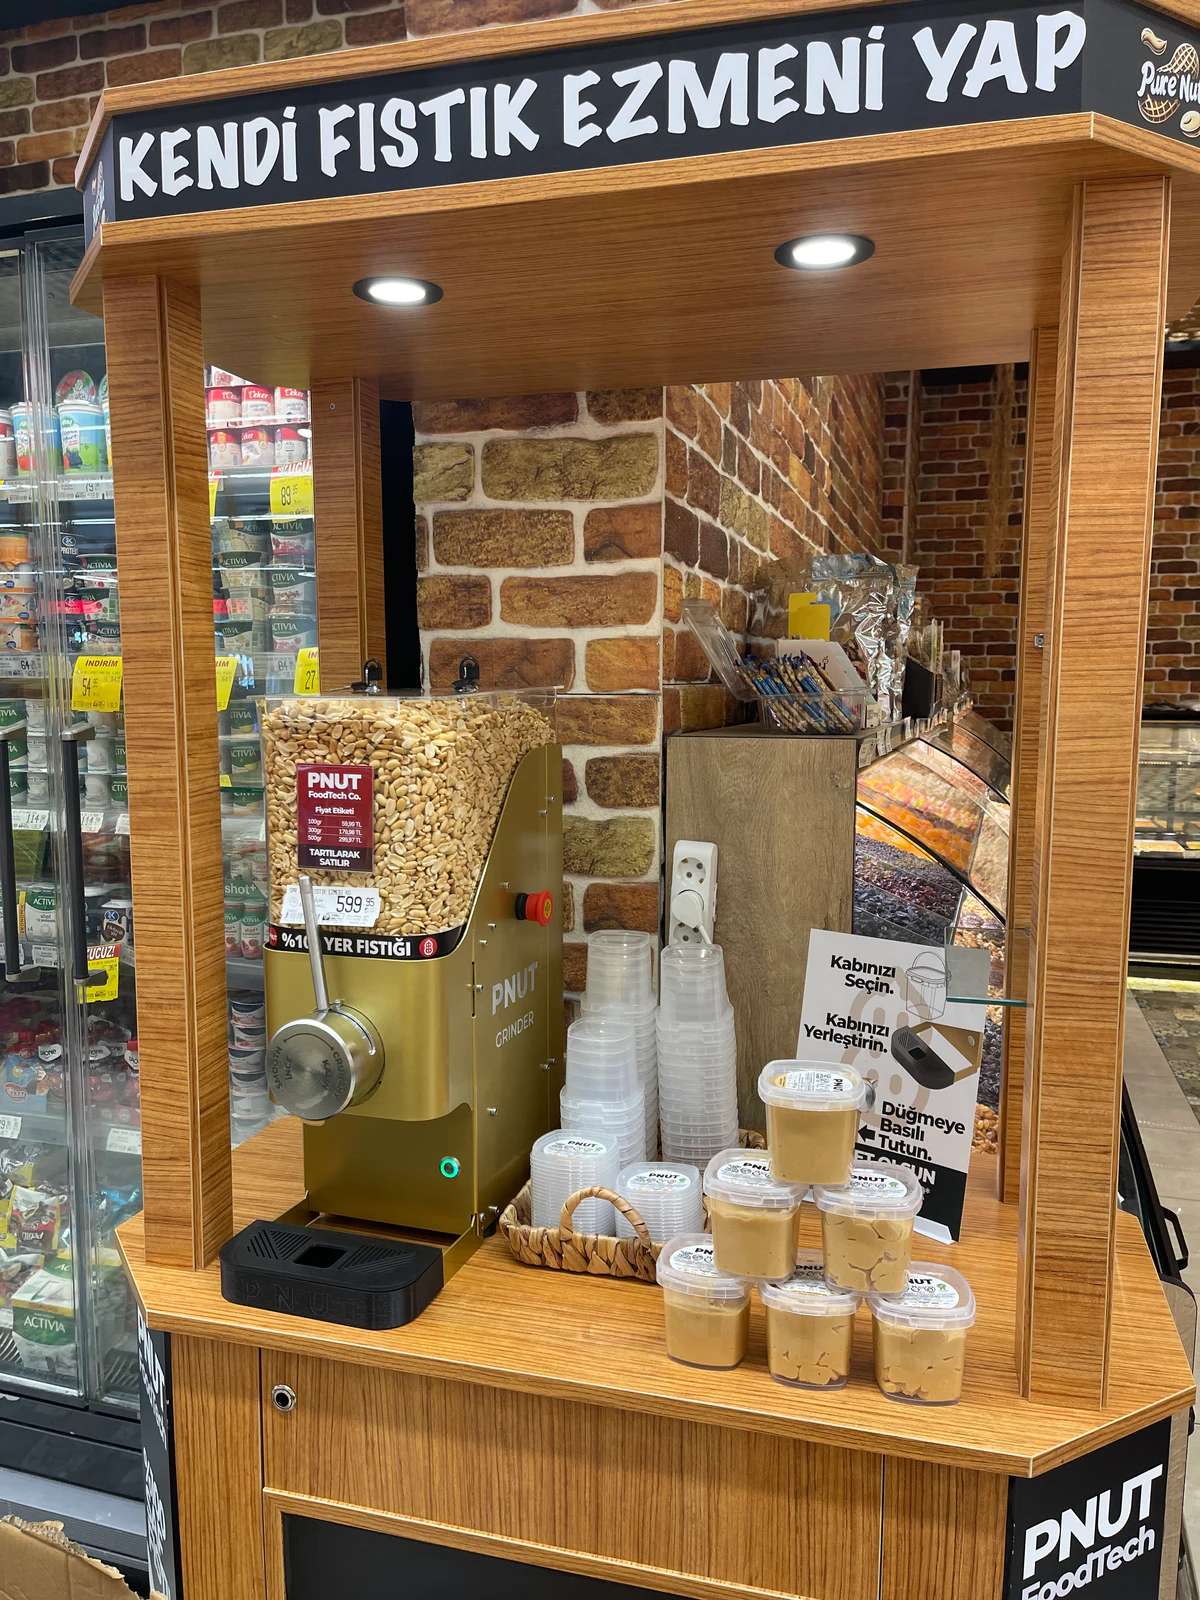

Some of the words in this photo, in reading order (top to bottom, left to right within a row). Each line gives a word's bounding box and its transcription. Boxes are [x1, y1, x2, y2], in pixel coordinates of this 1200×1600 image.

[1136, 60, 1177, 98] Pure
[119, 106, 298, 202] KENDİ
[318, 77, 539, 178] FISTIK
[562, 26, 885, 148] EZMENİ
[912, 10, 1087, 103] YAP
[280, 485, 292, 506] 89
[273, 522, 304, 531] ACTIVIA
[87, 561, 112, 569] ACTIVIA
[223, 557, 248, 566] ACTIVIA
[271, 573, 296, 582] CTIVIA
[85, 659, 118, 667] İNDİRİM
[230, 711, 252, 719] CTIVIA
[307, 772, 362, 790] PNUT
[308, 791, 347, 800] FoodTech
[348, 792, 361, 801] Co.
[315, 806, 332, 815] Fiyat
[333, 807, 355, 815] Etiketi
[307, 818, 322, 826] 100gr
[309, 848, 361, 859] TARTILARAK
[319, 858, 350, 867] SATILIR
[281, 932, 309, 950] %10
[324, 936, 353, 954] YER
[356, 938, 411, 957] FISTIĞI
[830, 954, 896, 979] Kabınızı
[491, 961, 539, 1017] PNUT
[844, 974, 895, 995] Seçin.
[495, 1010, 535, 1049] GRINDER
[825, 1012, 890, 1037] Kabınızı
[804, 1024, 888, 1053] Yerleştirin.
[272, 1046, 283, 1090] SMOOTH
[881, 1100, 966, 1135] Düğmeye
[879, 1117, 925, 1142] Basılı
[567, 1140, 598, 1148] PNUT
[877, 1134, 933, 1161] Tutun.
[743, 1161, 770, 1172] PNU
[648, 1172, 681, 1180] PNUT
[695, 1247, 714, 1256] PN
[909, 1277, 933, 1286] NUT
[24, 1315, 66, 1334] ACTIVIA
[1022, 1463, 1164, 1581] PNUT
[1022, 1525, 1156, 1600] FoodTech
